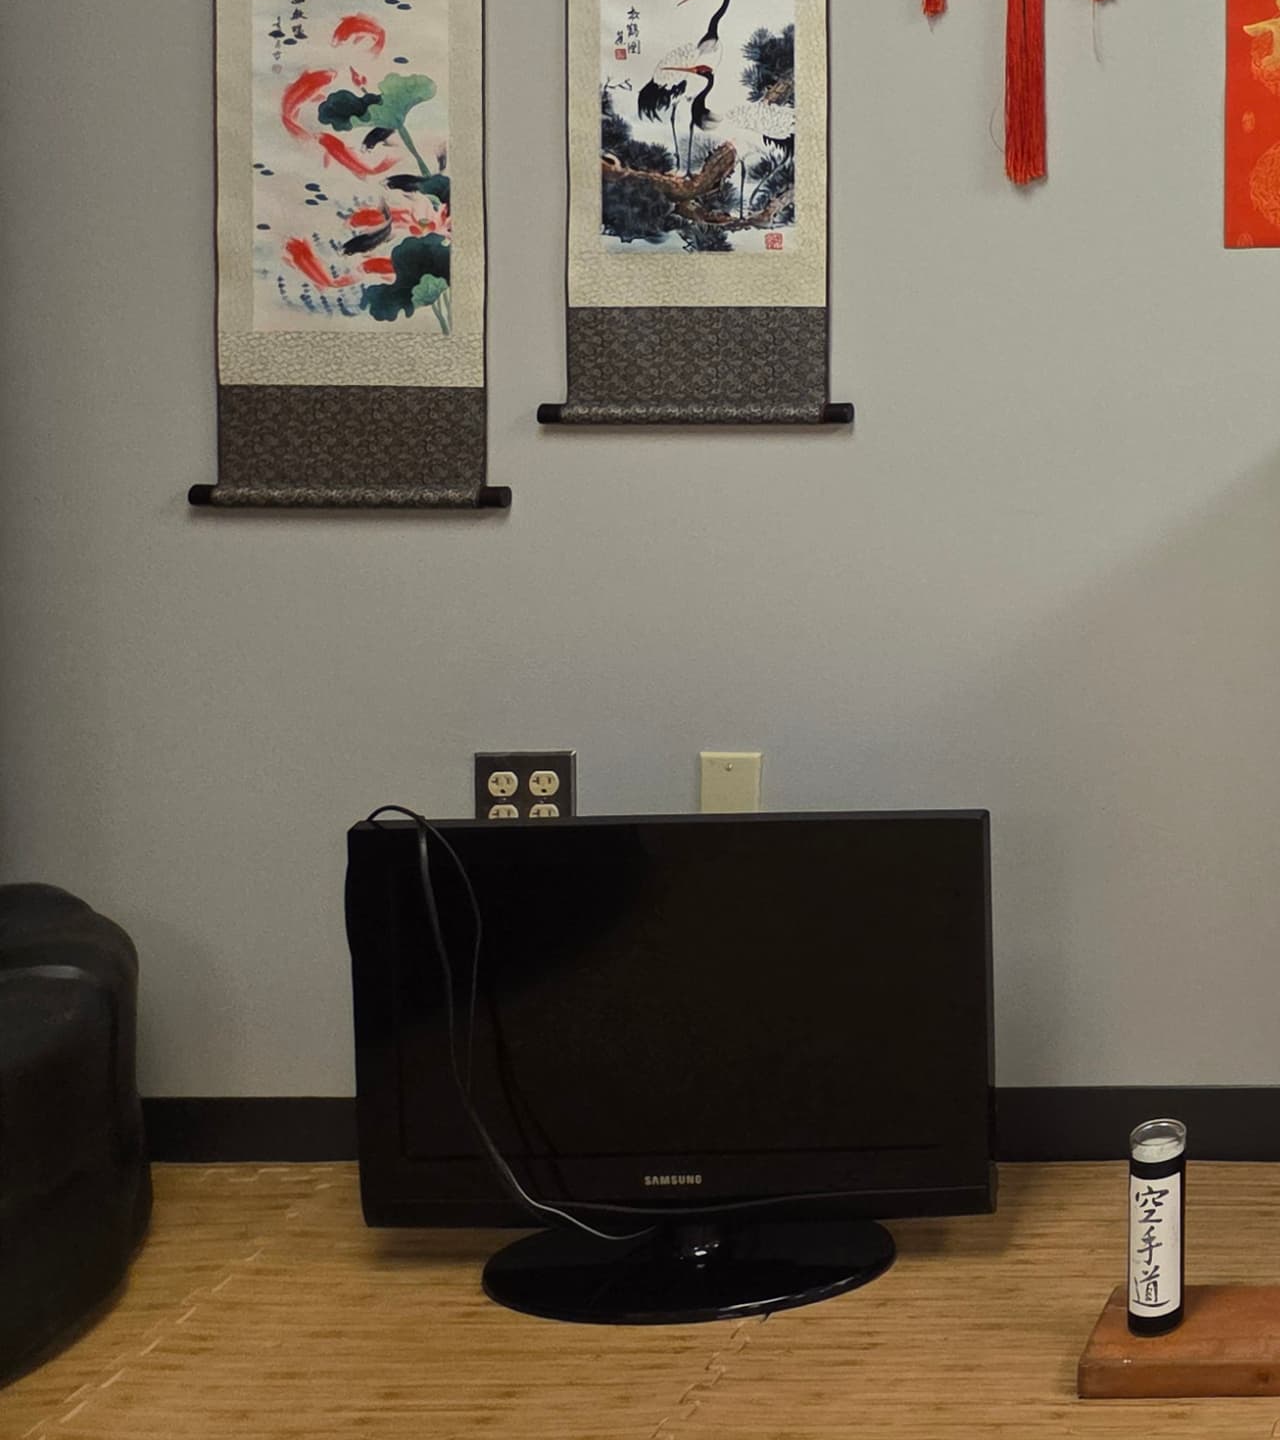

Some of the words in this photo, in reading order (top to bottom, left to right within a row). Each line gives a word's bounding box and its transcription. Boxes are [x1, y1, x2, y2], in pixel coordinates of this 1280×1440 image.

[643, 1174, 703, 1186] SAMSUNG
[1132, 1184, 1171, 1308] 空手道
